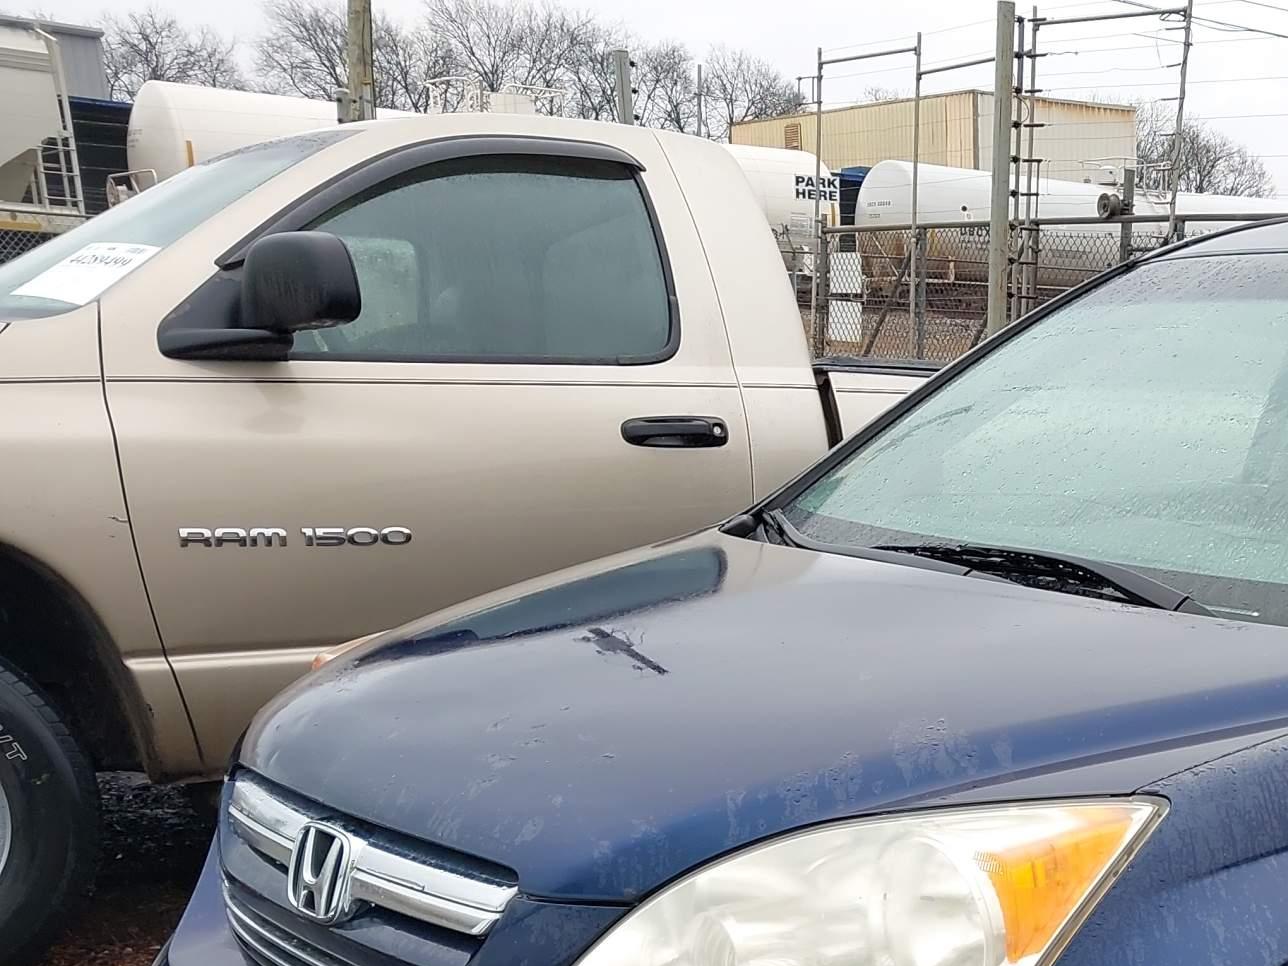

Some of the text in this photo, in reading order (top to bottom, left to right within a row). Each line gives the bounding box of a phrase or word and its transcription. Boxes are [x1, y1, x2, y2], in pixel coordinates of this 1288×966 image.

[795, 175, 838, 190] PARK
[795, 187, 838, 201] HERE
[178, 526, 413, 548] RAM 1500
